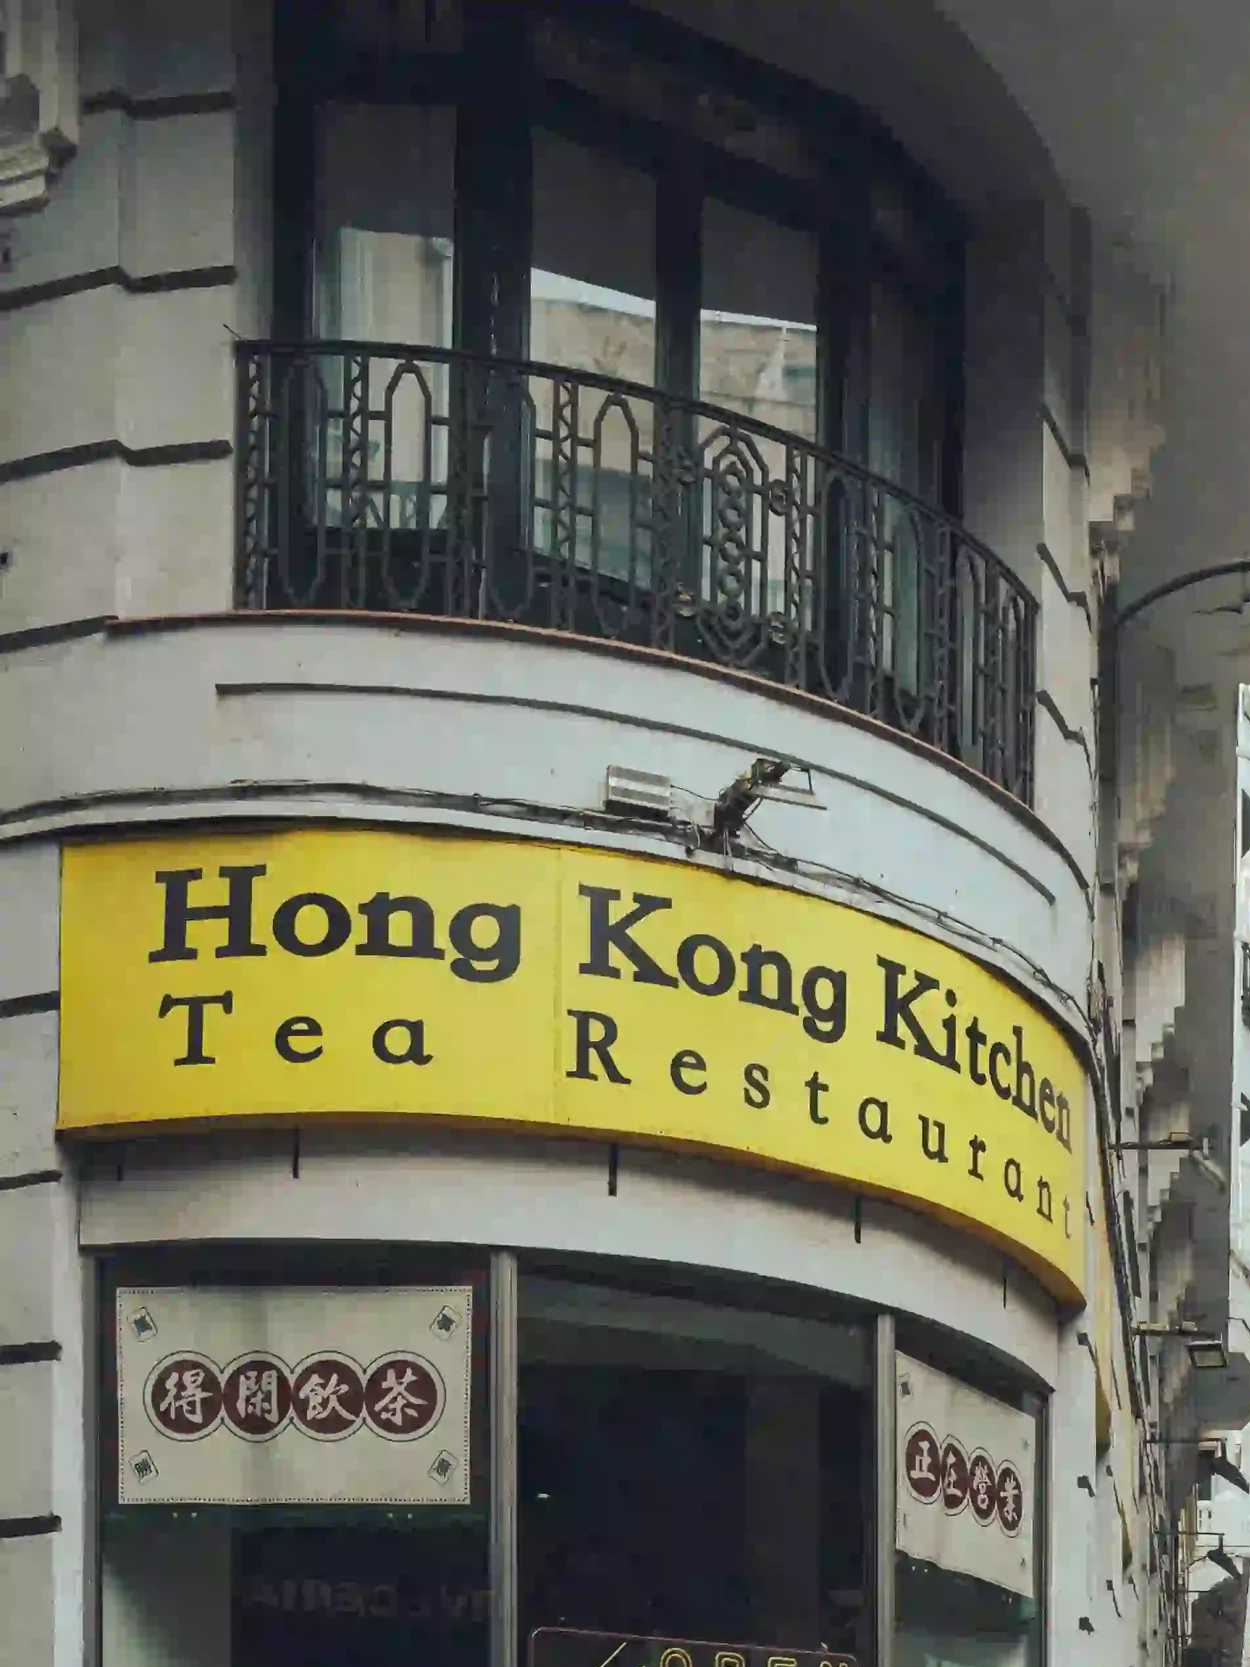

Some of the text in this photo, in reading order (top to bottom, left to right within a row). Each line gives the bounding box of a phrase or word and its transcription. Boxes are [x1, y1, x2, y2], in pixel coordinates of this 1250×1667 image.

[148, 864, 1073, 1154] Hong Kong Kitchen
[158, 990, 1072, 1239] Tea Restaurant
